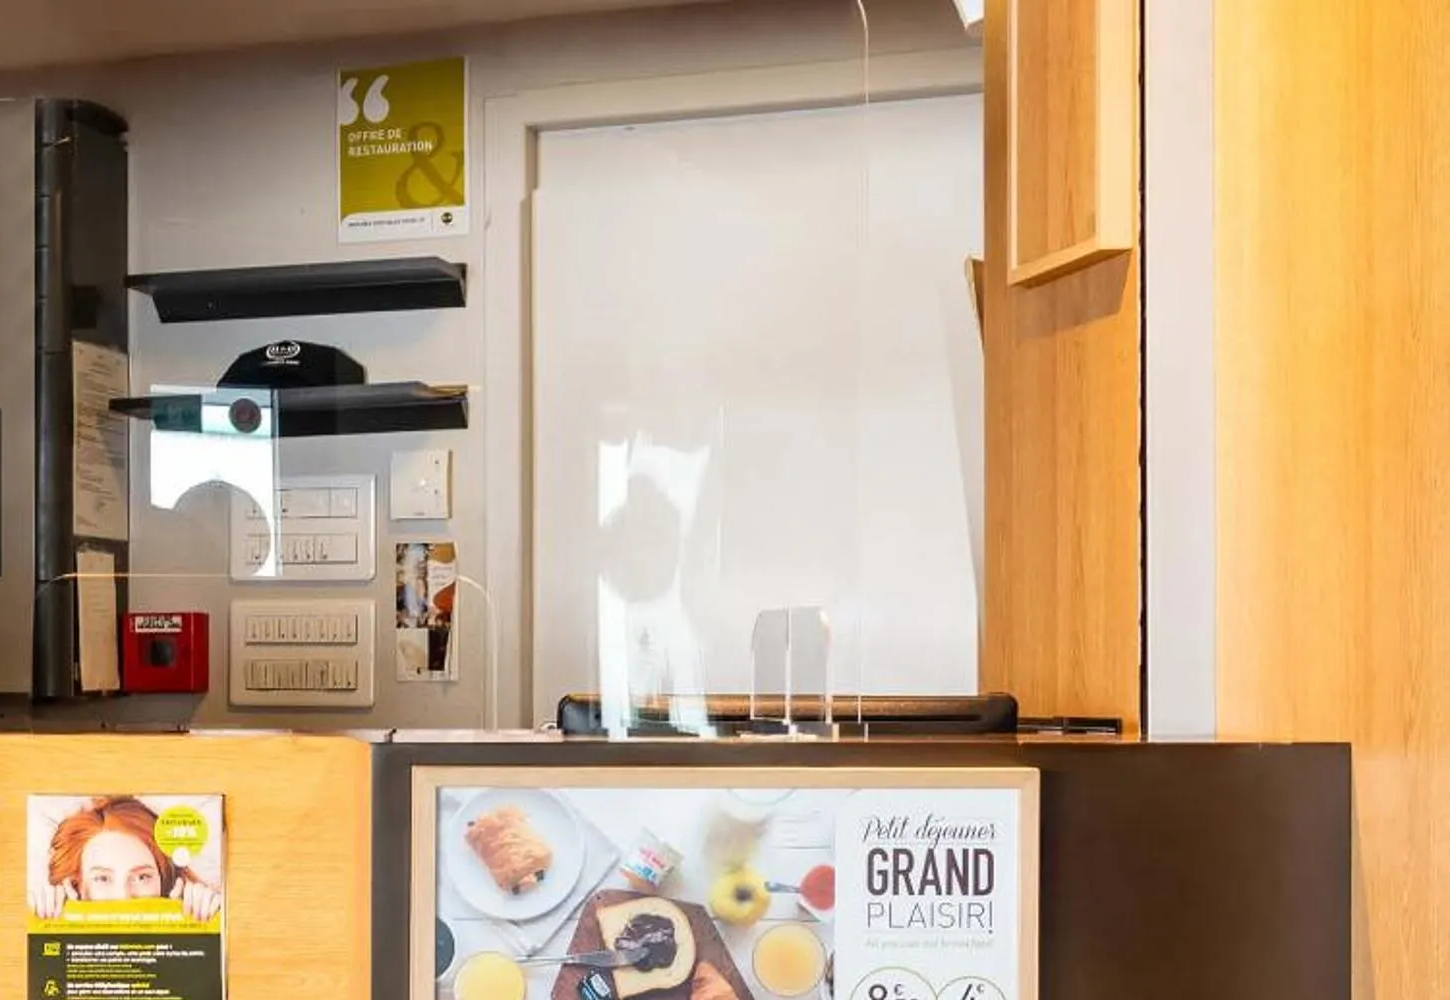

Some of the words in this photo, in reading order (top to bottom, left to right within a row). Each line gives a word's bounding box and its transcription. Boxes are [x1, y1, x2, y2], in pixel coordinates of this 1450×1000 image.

[347, 130, 384, 143] OFFRE
[387, 128, 401, 139] DE
[347, 141, 433, 157] RESTAURATION
[862, 814, 910, 842] Petit
[915, 813, 995, 849] déjeuner
[867, 848, 995, 896] GRAND
[867, 900, 993, 934] PLAISIR!
